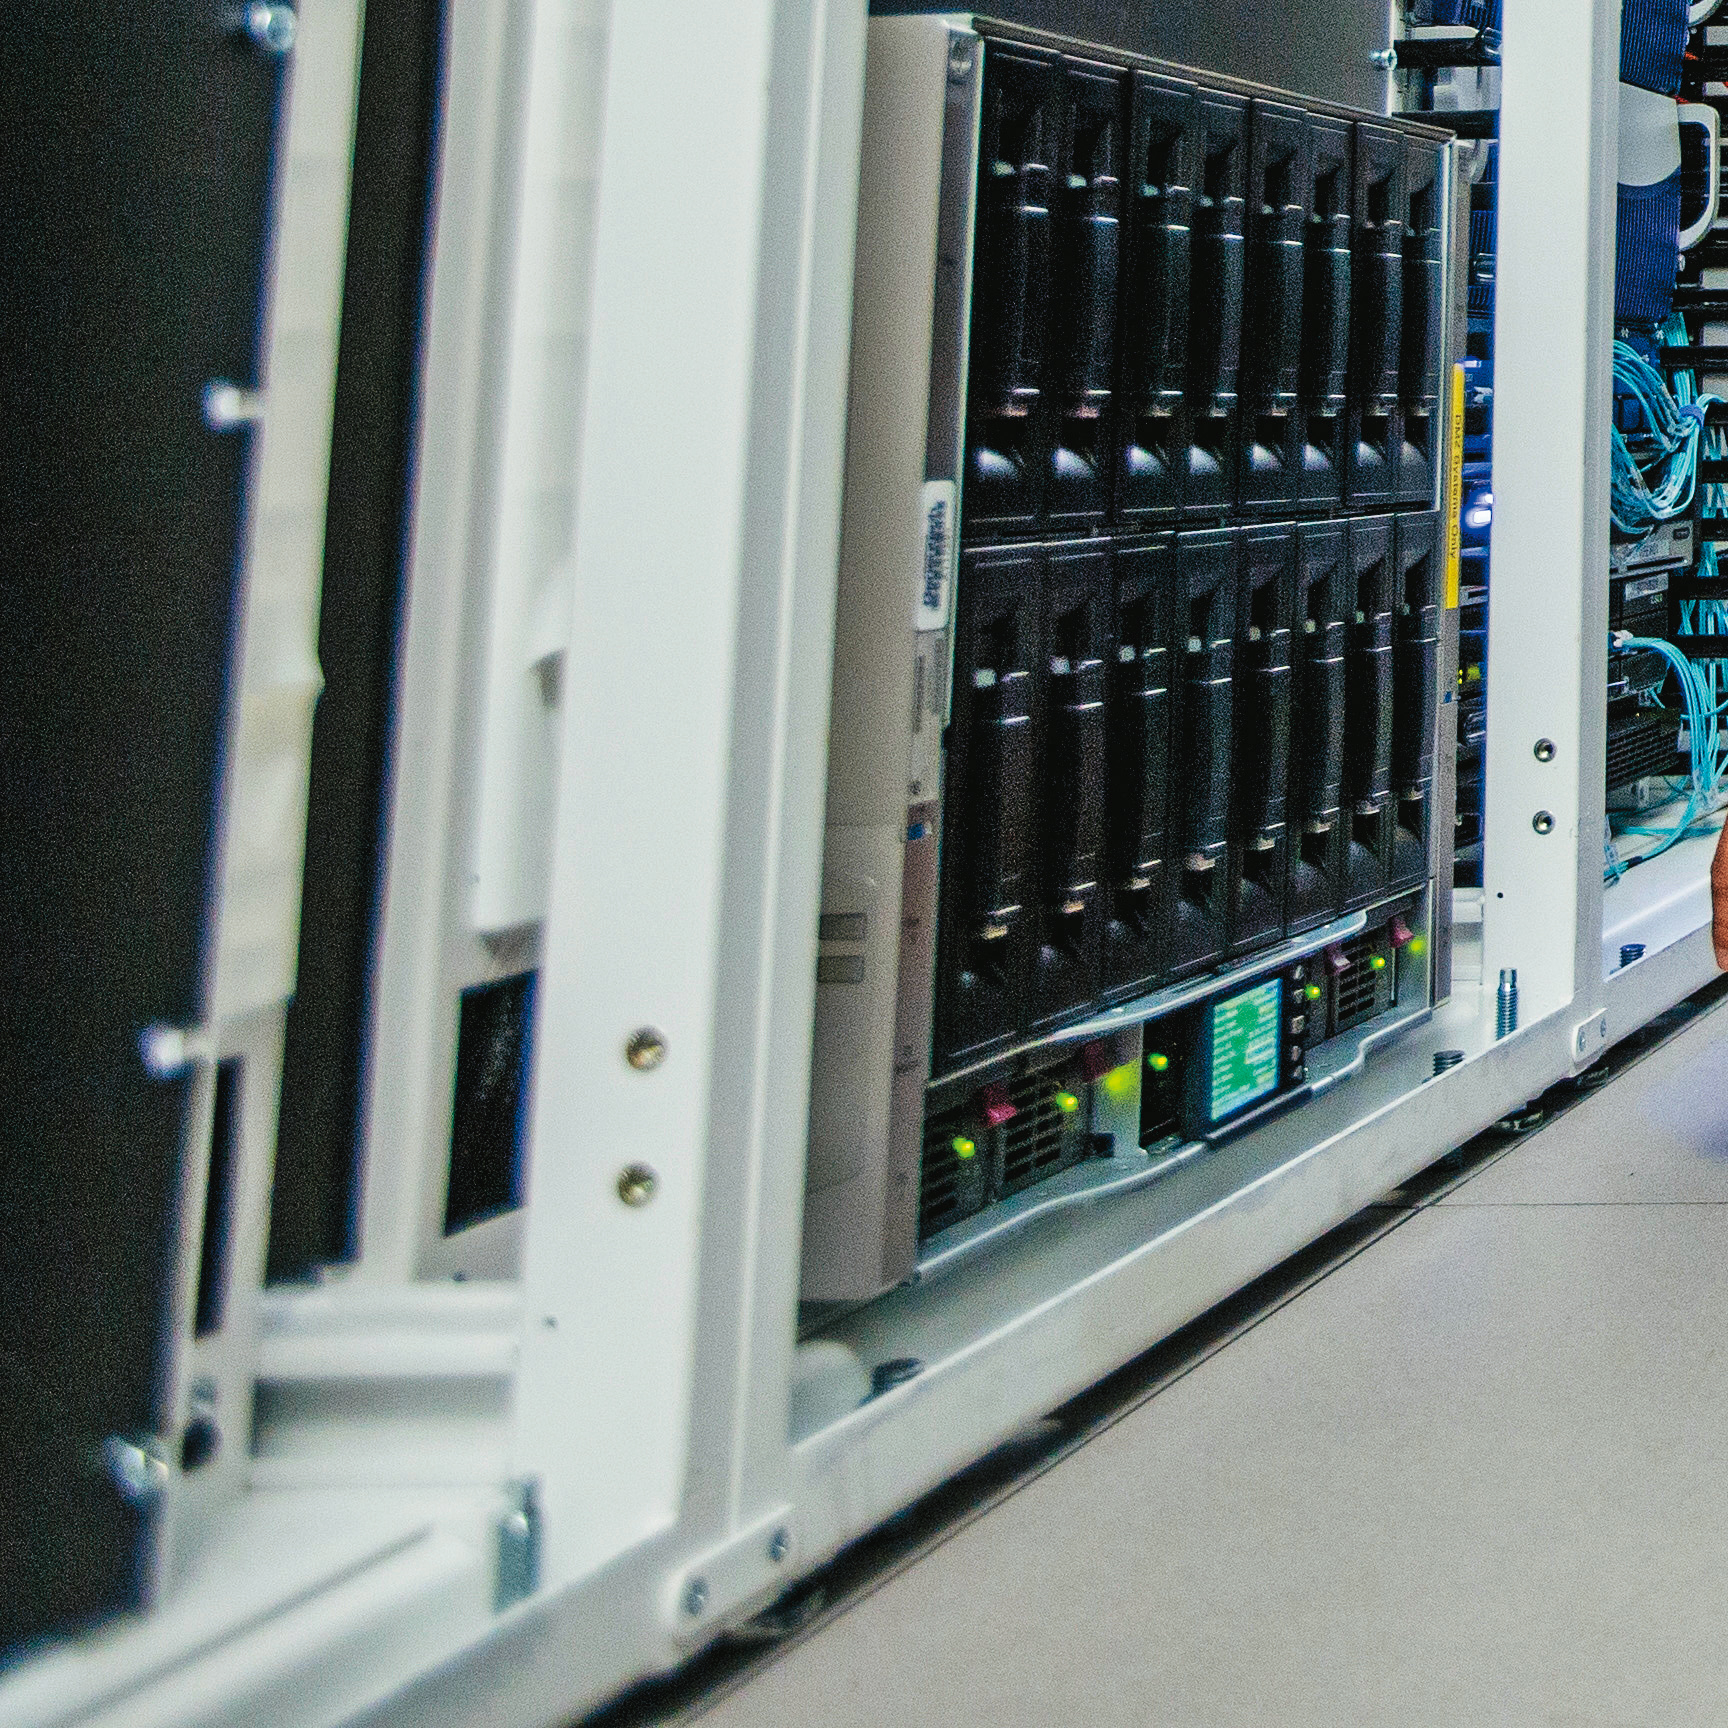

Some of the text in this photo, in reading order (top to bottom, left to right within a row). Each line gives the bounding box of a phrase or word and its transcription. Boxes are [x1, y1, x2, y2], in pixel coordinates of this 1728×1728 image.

[1449, 413, 1463, 560] DMZ Systems Only
